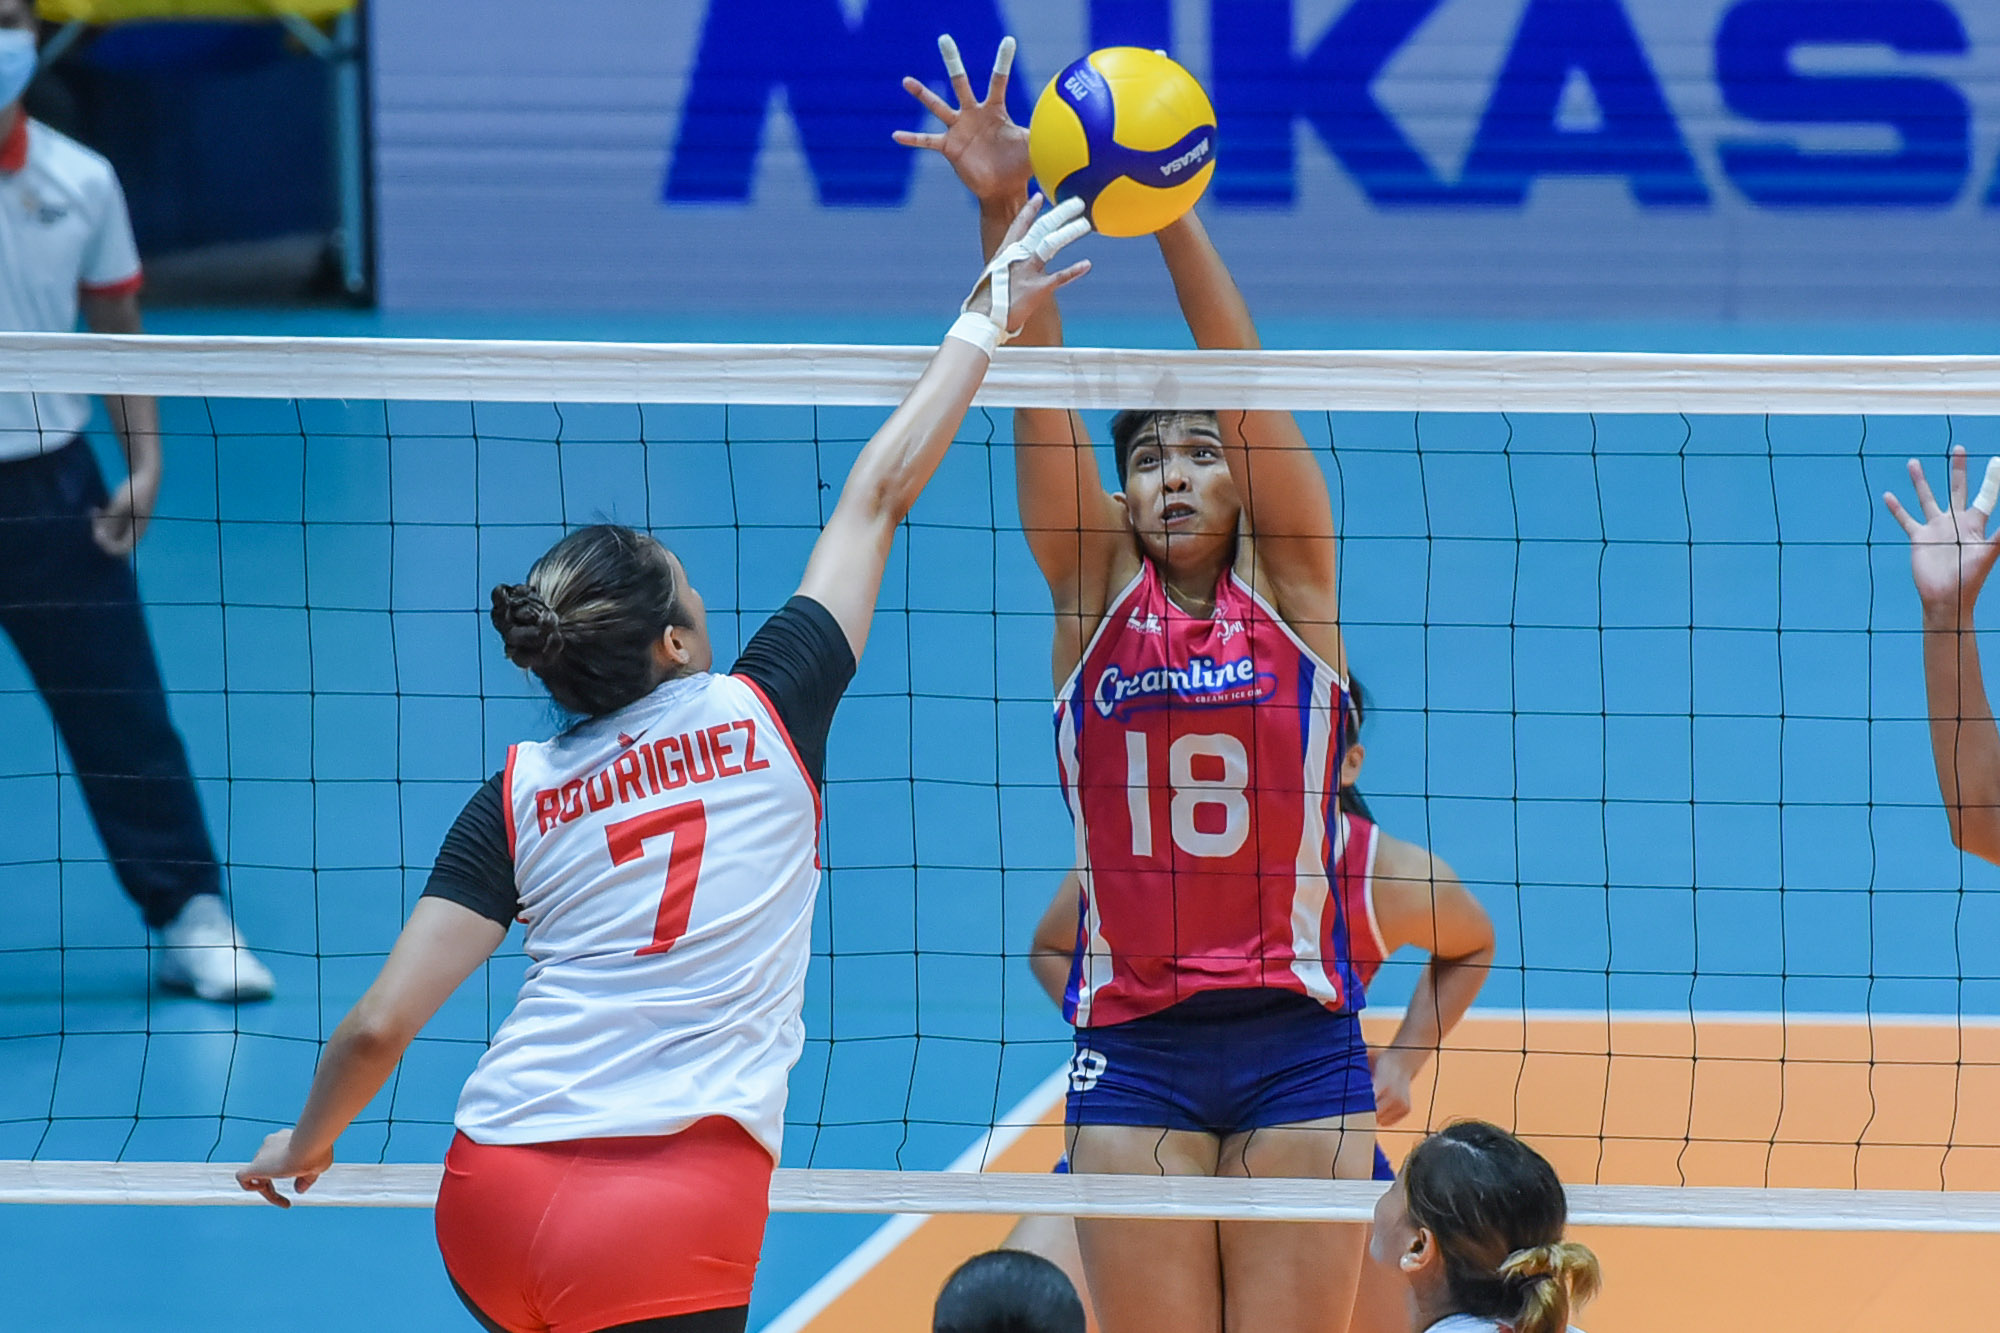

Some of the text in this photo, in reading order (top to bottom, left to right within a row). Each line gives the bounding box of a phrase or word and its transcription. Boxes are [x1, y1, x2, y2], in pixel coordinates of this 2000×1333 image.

[663, 0, 2000, 208] MKAS
[1095, 657, 1253, 716] Creamline
[534, 718, 769, 836] RODRIGUEZ
[1125, 730, 1250, 857] 18
[605, 799, 707, 956] 7
